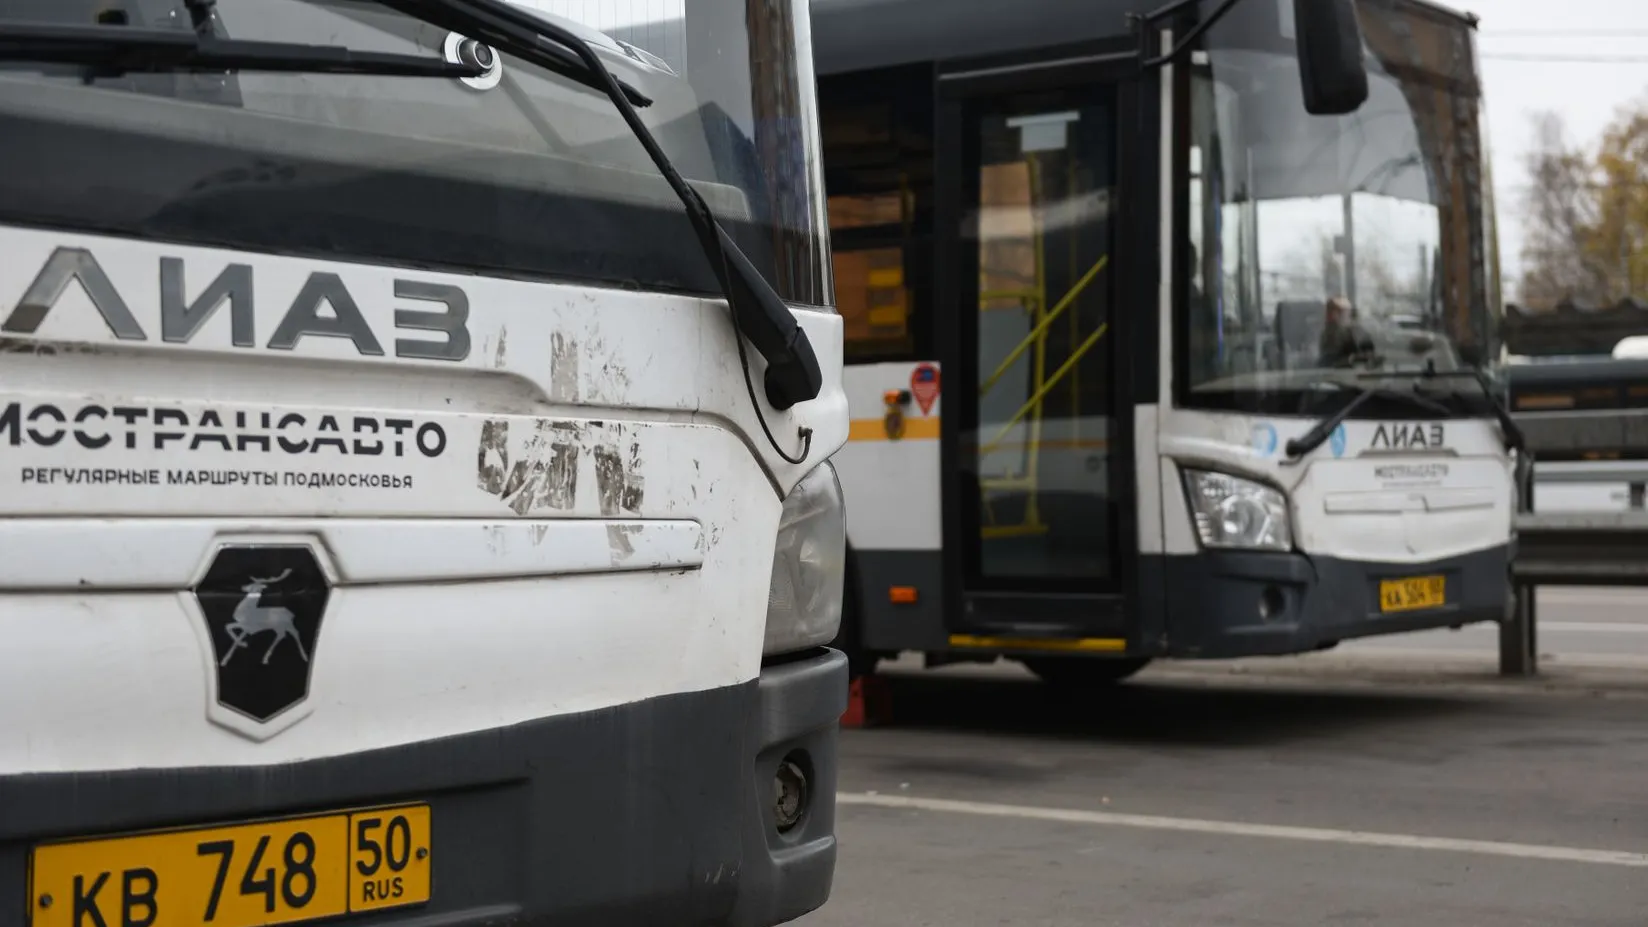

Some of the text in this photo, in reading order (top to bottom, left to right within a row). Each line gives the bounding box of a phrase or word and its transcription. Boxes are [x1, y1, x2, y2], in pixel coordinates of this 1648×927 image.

[2, 246, 472, 361] ЛИАЗ
[1371, 423, 1444, 448] ЛИАЗ
[21, 467, 413, 489] РЕГУЛЯРНЫЕ МАРШРУТЫ ПОДМОСКОВЬЯ
[356, 815, 411, 876] 50
[73, 831, 317, 927] КВ 748
[363, 878, 404, 902] RUS
